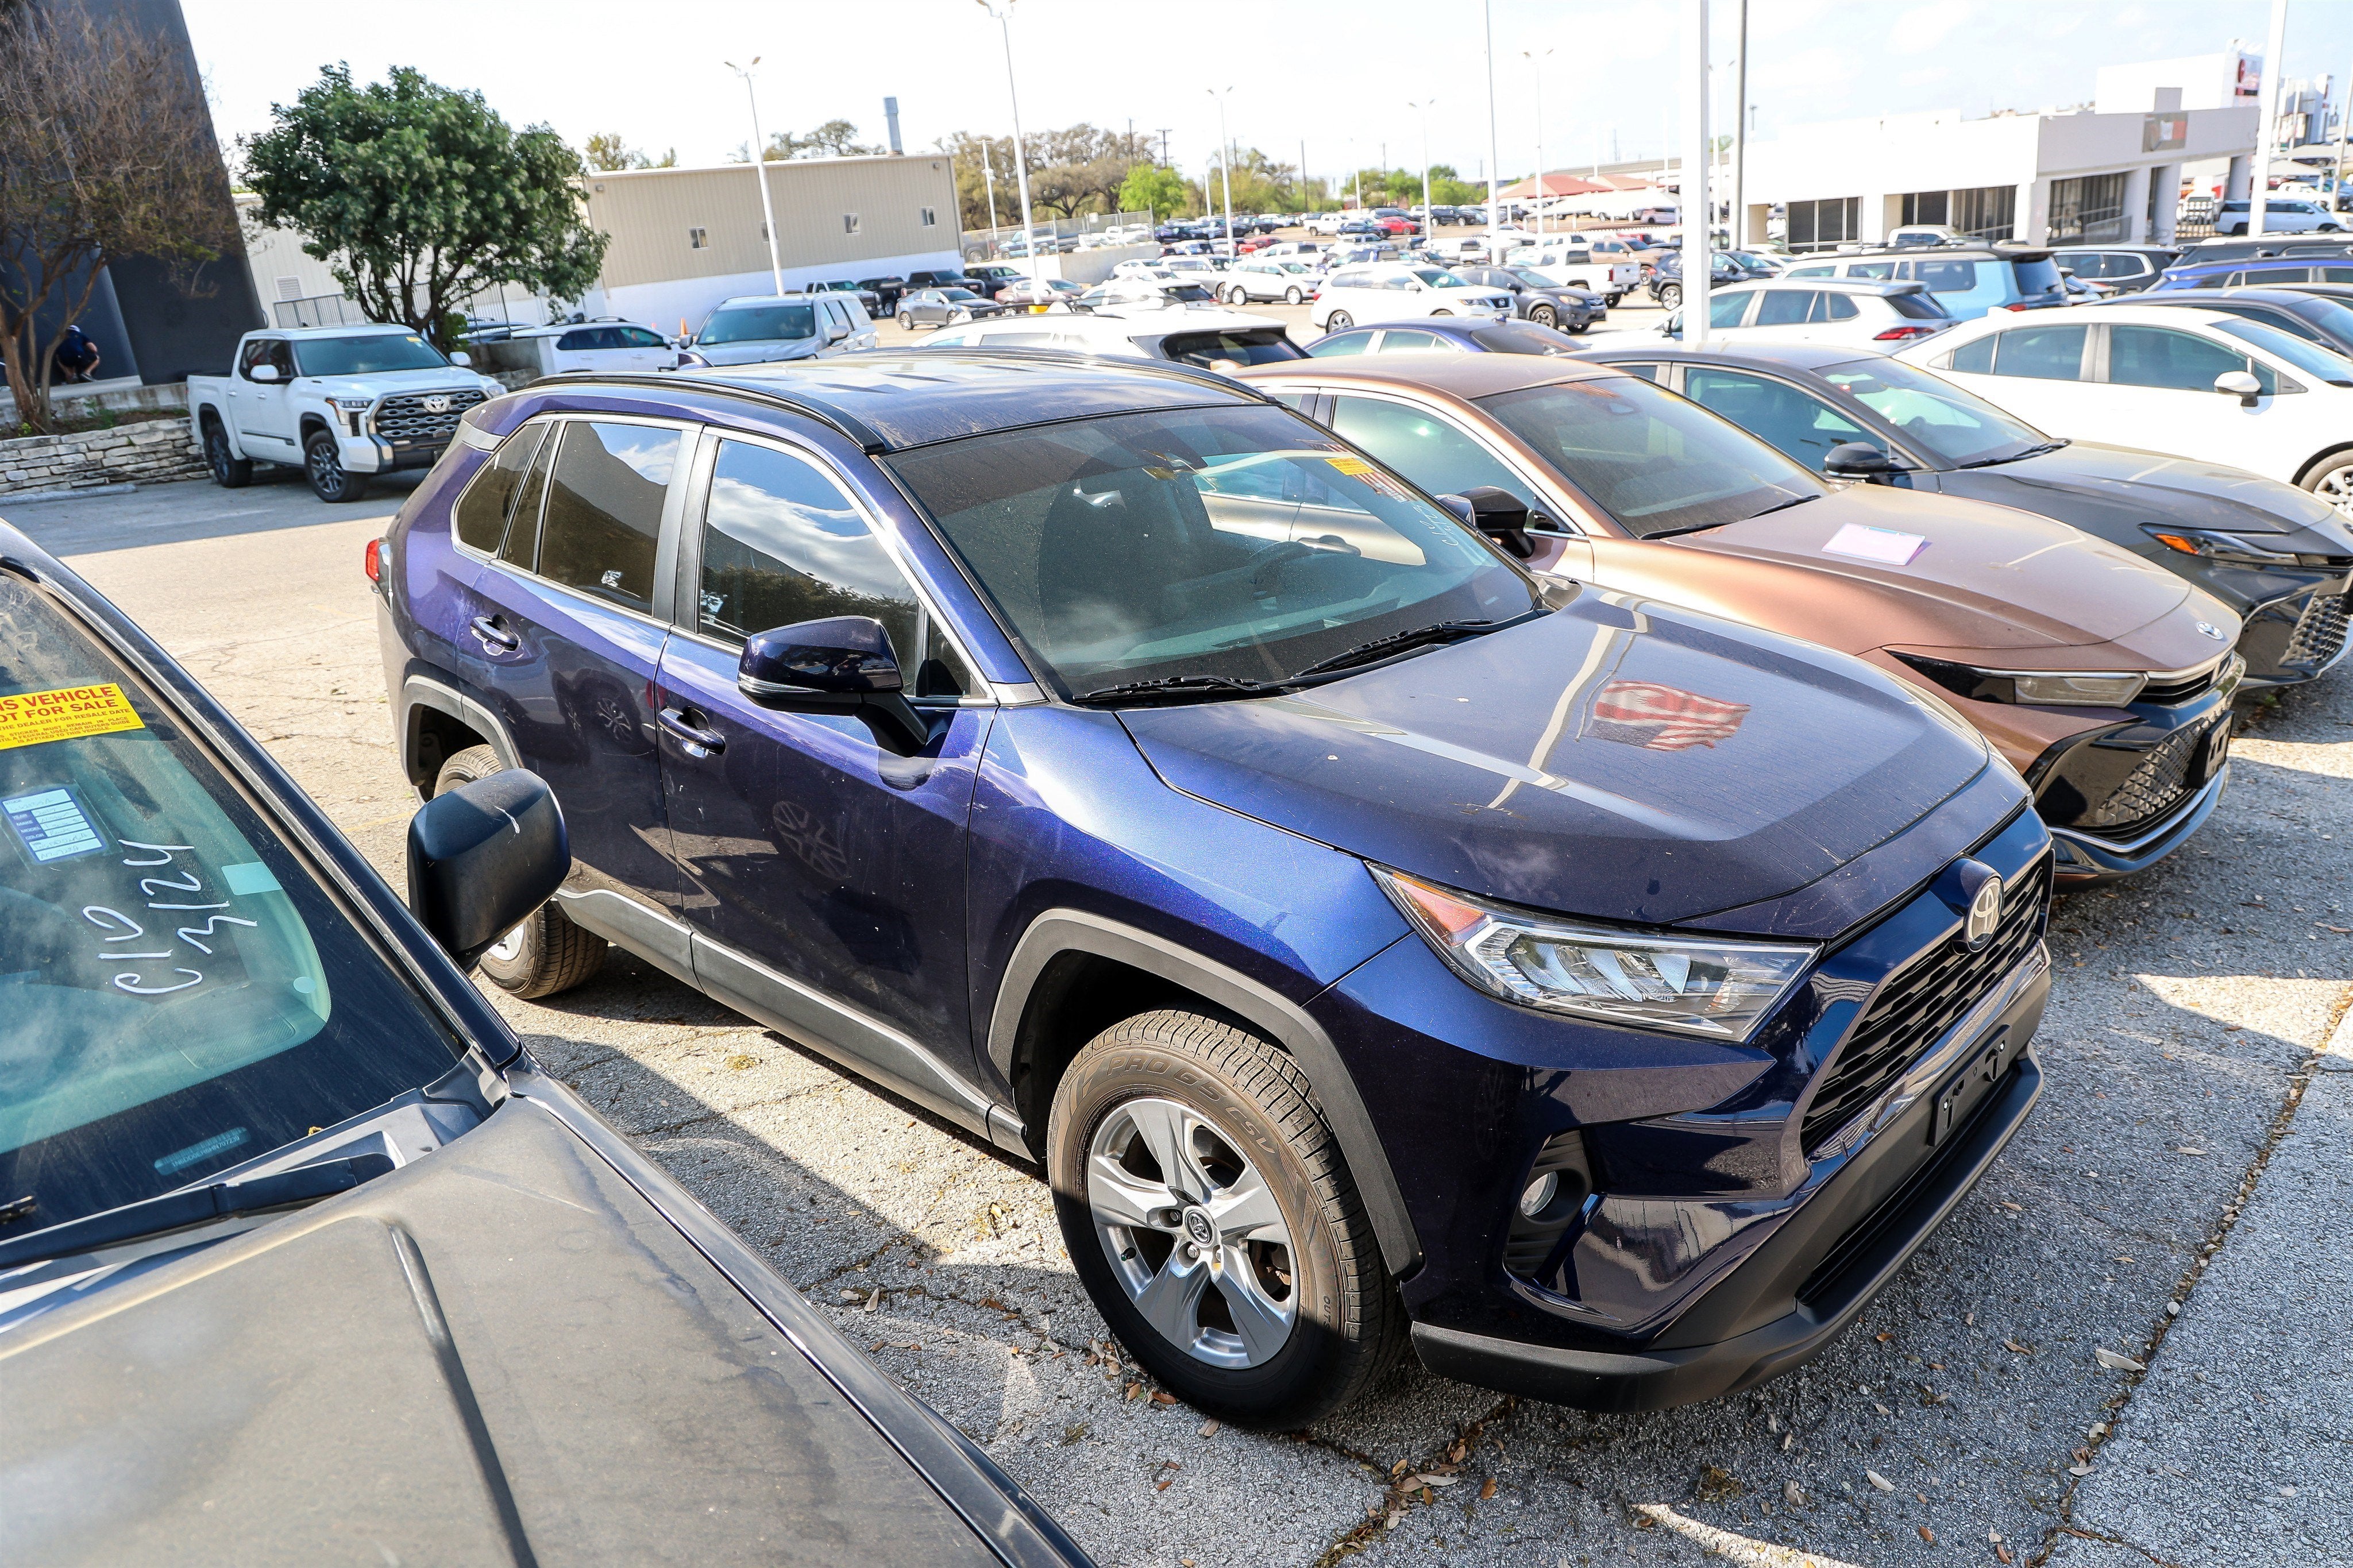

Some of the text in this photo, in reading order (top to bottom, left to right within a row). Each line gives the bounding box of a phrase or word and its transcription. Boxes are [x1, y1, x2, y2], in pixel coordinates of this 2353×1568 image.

[22, 686, 117, 707] VEHICLE
[17, 719, 52, 728] DEALER
[74, 711, 108, 719] RESALE
[24, 706, 65, 719] FOR
[70, 699, 118, 712] SALE
[82, 905, 204, 995] C10
[1108, 1055, 1172, 1076] PRO
[1225, 1106, 1276, 1154] CSV
